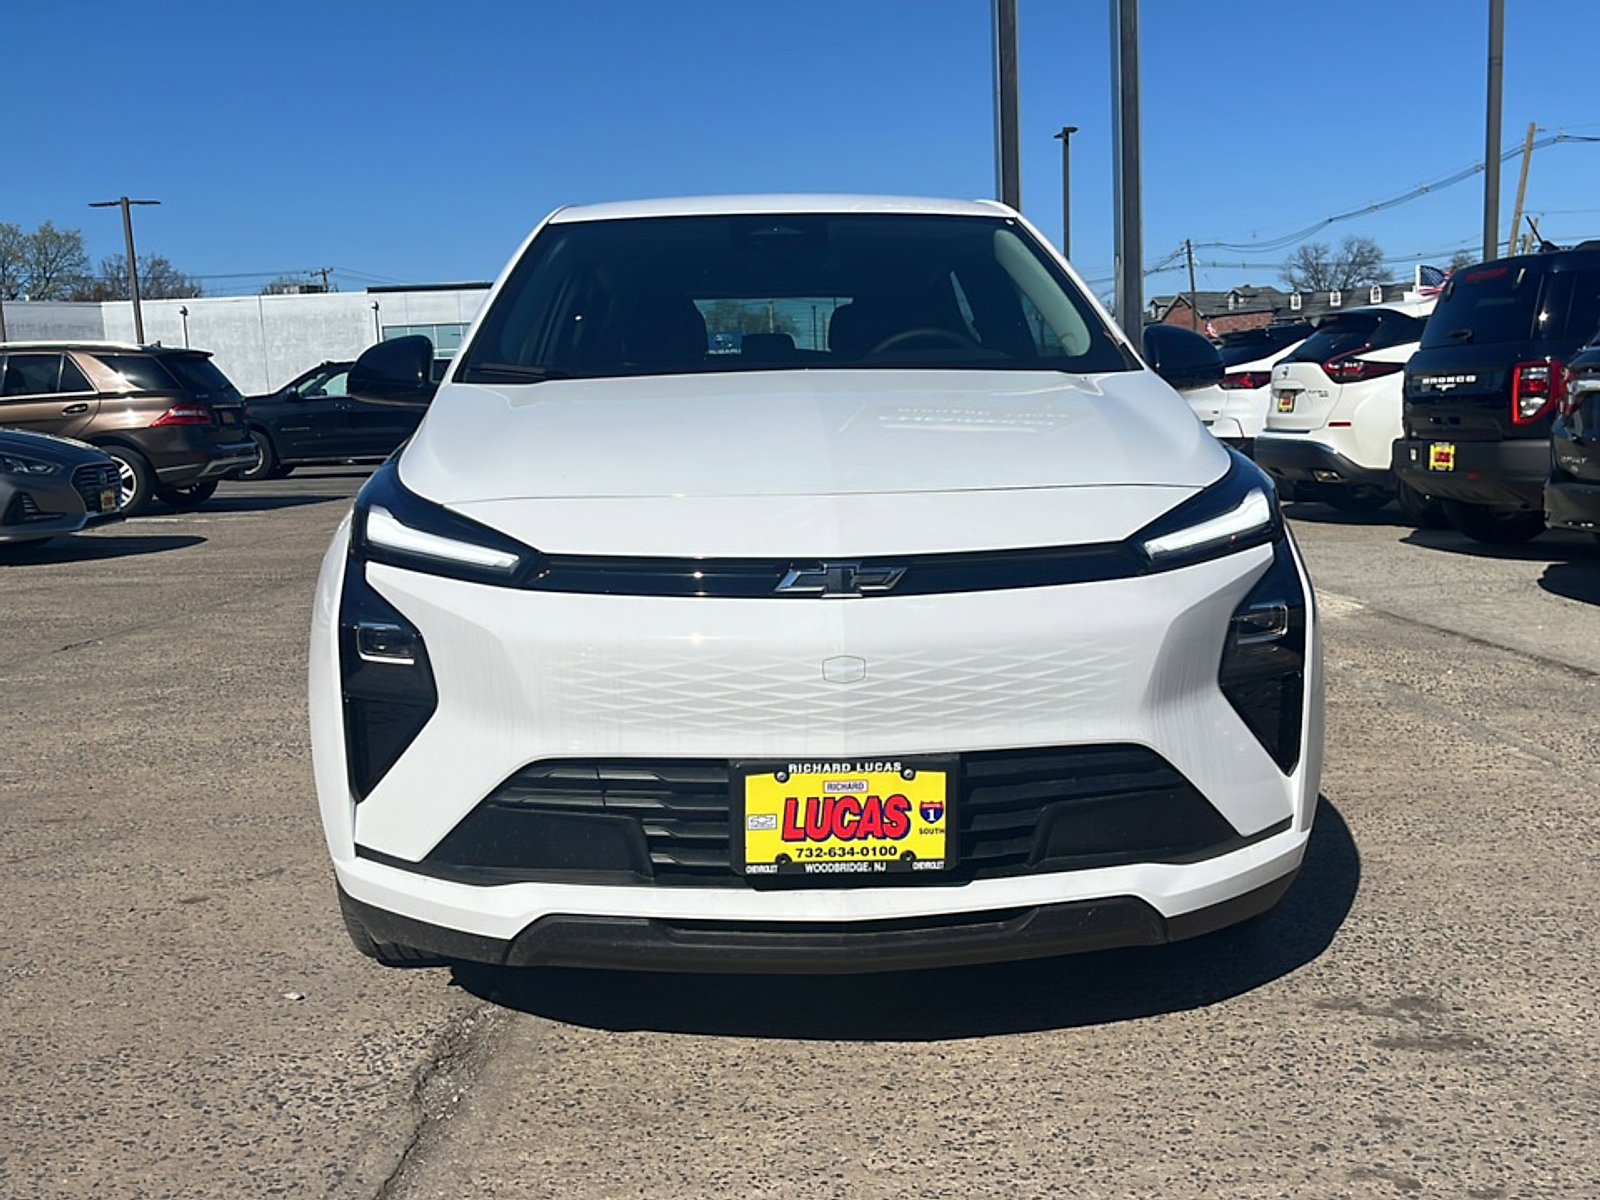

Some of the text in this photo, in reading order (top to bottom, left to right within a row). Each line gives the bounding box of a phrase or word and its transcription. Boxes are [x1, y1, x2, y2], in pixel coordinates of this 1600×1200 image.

[1421, 375, 1476, 385] BRONCO
[788, 761, 902, 774] RICHARD LUCAS
[827, 782, 865, 792] RICHARD
[781, 794, 912, 842] LUCAS
[927, 808, 935, 822] 1
[795, 846, 898, 858] 732-634-0100
[874, 861, 887, 872] NJ
